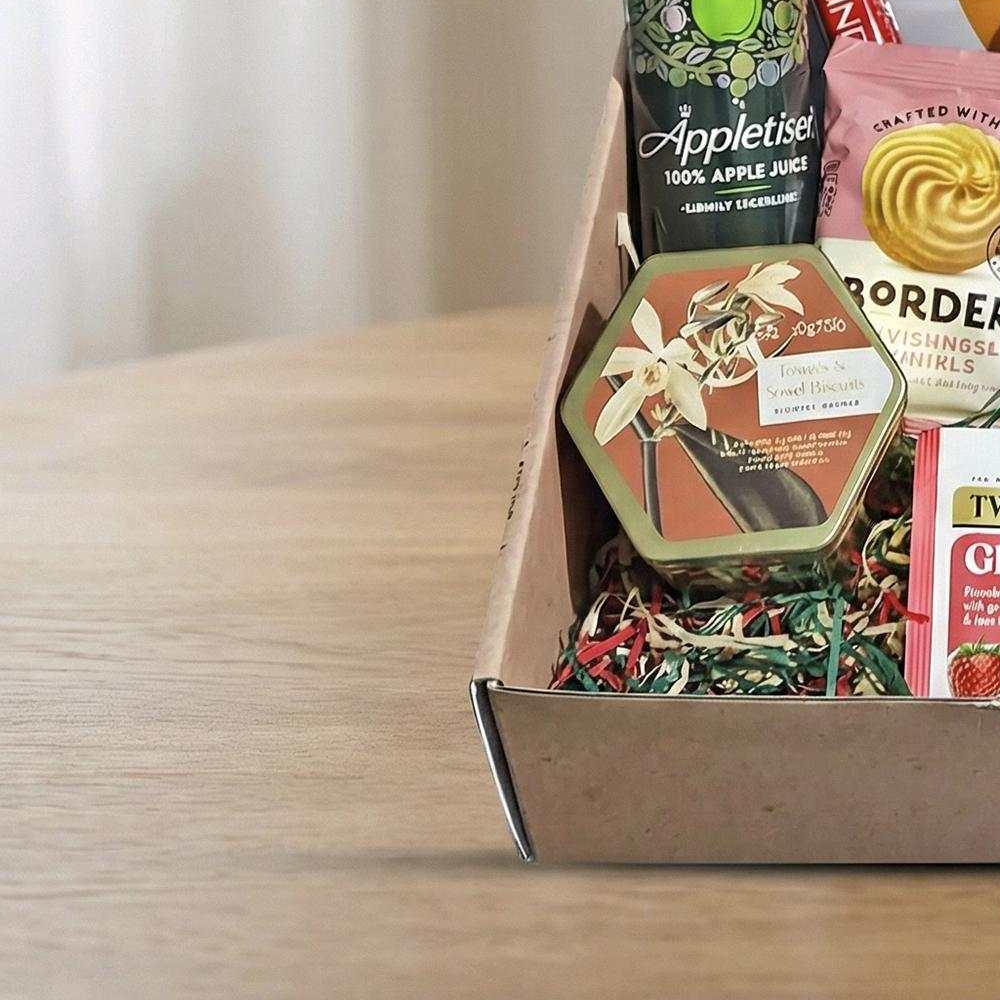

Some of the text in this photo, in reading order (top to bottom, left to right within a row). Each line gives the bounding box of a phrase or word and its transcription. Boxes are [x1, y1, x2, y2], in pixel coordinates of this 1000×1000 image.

[873, 106, 948, 133] CRAFTED
[956, 106, 1000, 131] WITH
[664, 155, 810, 186] 100% APPLE JUICE
